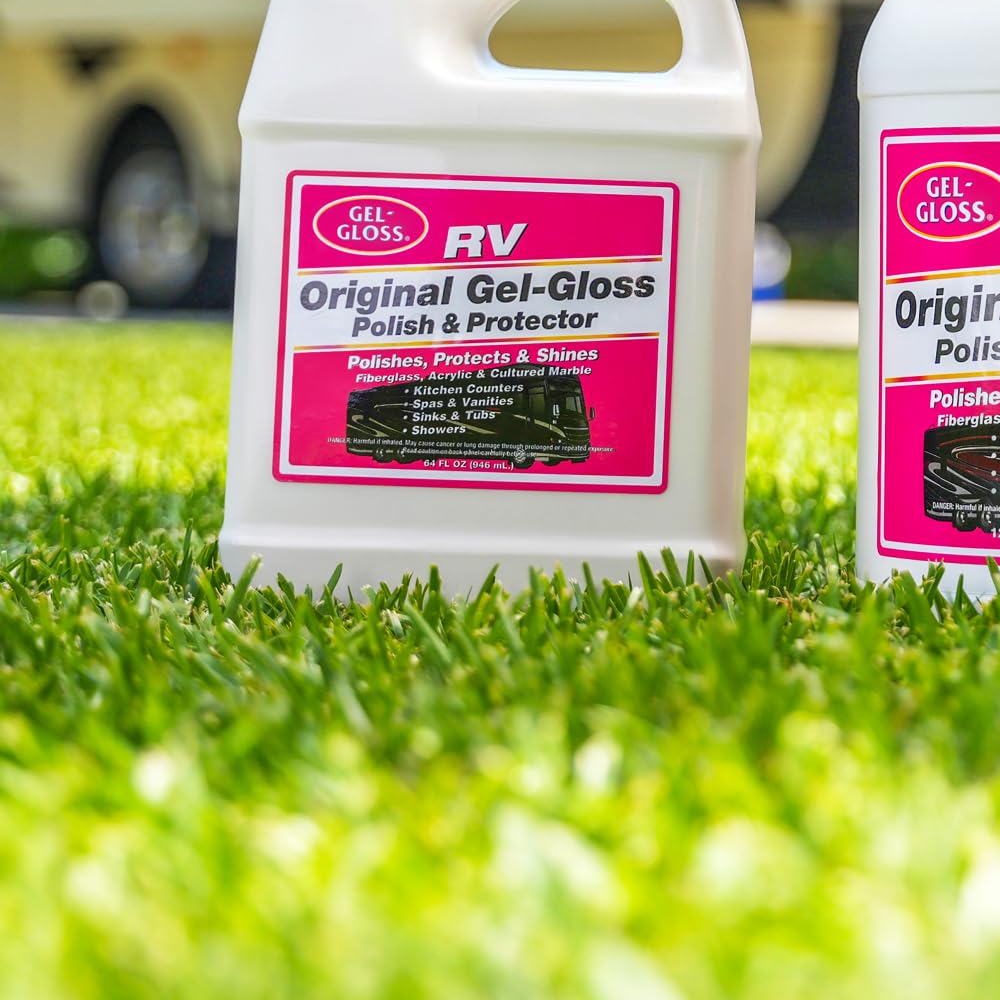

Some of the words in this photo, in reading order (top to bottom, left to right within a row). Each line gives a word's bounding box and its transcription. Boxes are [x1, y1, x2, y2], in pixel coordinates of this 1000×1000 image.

[926, 177, 973, 198] GEL-
[349, 206, 394, 222] GEL-
[443, 223, 528, 259] RV
[300, 276, 454, 314] Original
[466, 270, 655, 304] Gel-Gloss
[351, 311, 434, 337] Polish
[441, 313, 460, 333] &
[467, 310, 598, 333] Protector
[347, 354, 428, 369] Polishes,
[433, 351, 511, 366] Protects
[516, 349, 530, 364] &
[536, 347, 599, 363] Shines
[356, 373, 424, 384] Fiberglass,
[428, 370, 472, 381] Acrylic
[476, 369, 486, 379] &
[490, 367, 545, 378] Cultured
[549, 365, 592, 376] Marble
[413, 384, 463, 395] Kitchen
[466, 383, 524, 394] Counters
[412, 400, 444, 411] Spas
[448, 398, 457, 408] &
[462, 396, 514, 407] Vanities
[412, 411, 446, 422] Sinks
[451, 411, 461, 421] &
[465, 410, 496, 420] Tubs
[411, 425, 466, 436] Showers
[405, 439, 417, 447] May
[453, 460, 466, 468] OZ
[470, 461, 490, 469] (946
[955, 503, 977, 511] Harmful
